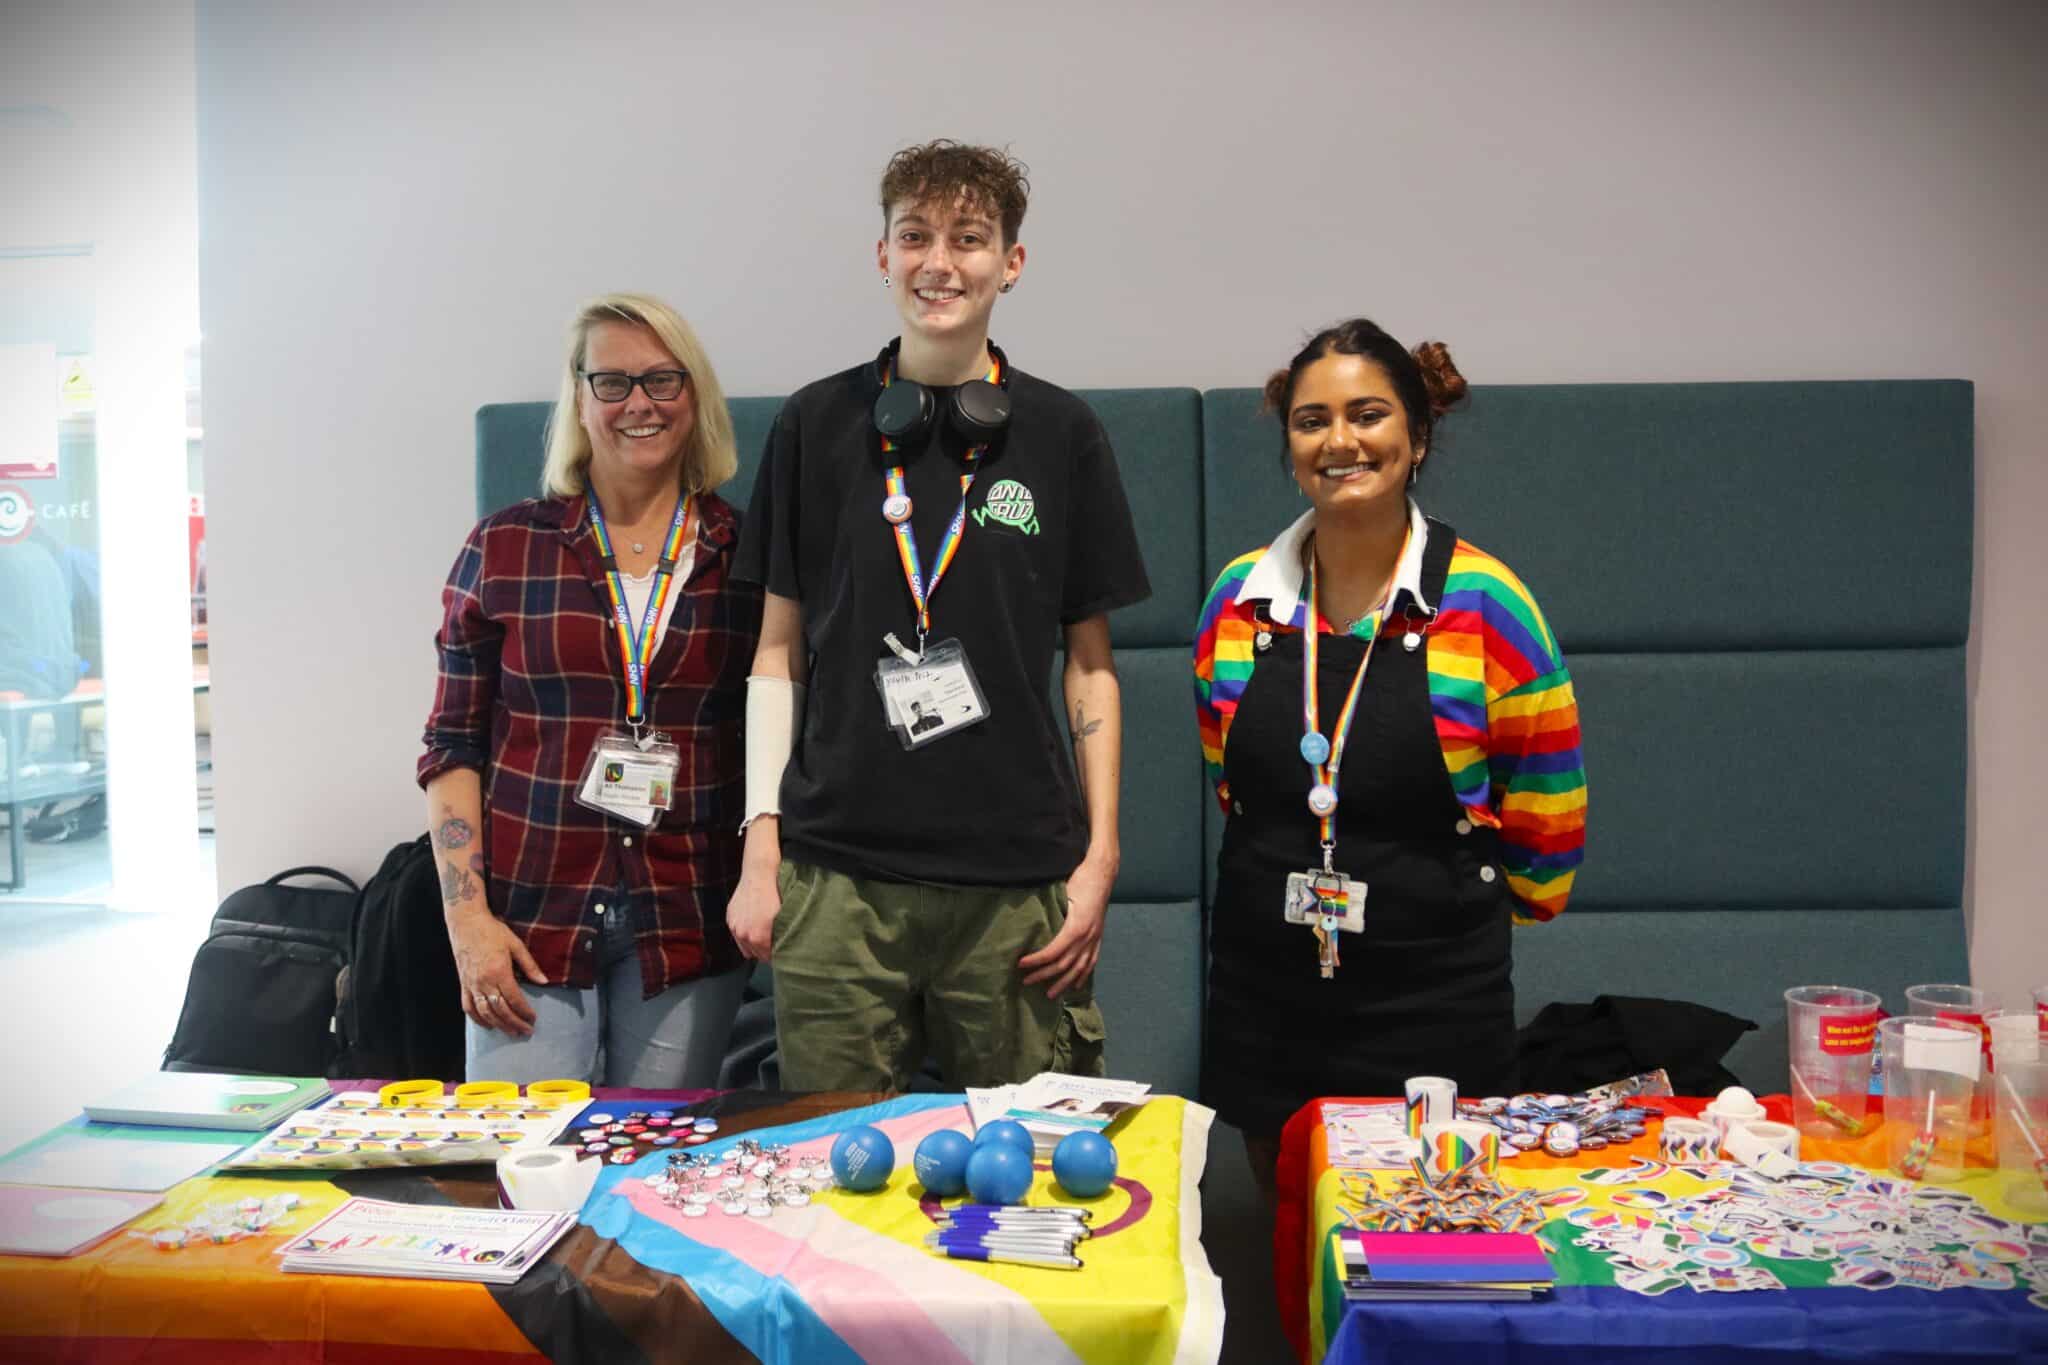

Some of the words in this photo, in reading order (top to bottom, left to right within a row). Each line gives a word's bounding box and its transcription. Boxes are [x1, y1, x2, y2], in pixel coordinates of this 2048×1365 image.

[616, 604, 629, 625] NHS
[644, 607, 660, 626] NHS
[628, 663, 641, 686] NHS
